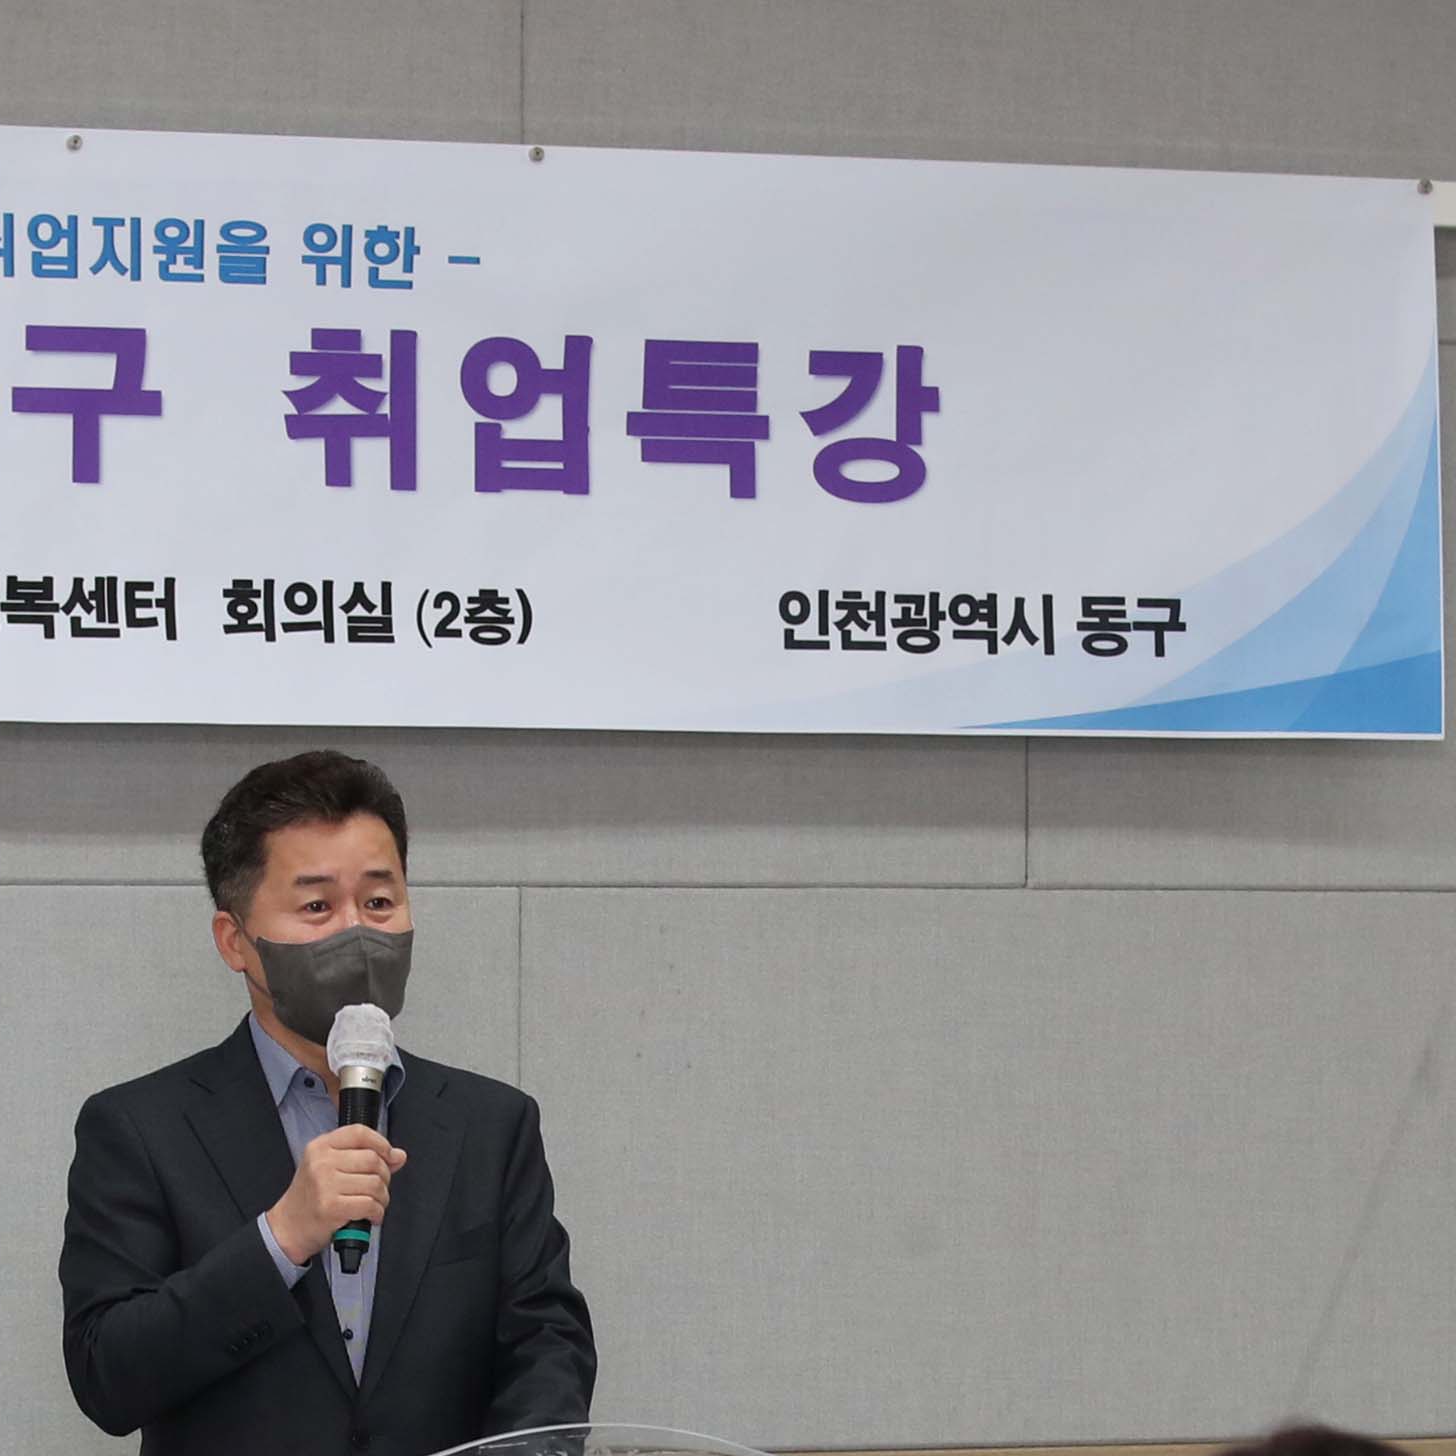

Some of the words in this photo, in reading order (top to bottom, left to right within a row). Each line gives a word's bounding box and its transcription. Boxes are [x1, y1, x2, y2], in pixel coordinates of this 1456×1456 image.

[302, 223, 421, 290] 위한
[285, 328, 942, 505] 취업특강
[222, 578, 397, 646] 회의실
[416, 588, 534, 649] (2층)
[778, 589, 1057, 657] 인천광역시
[1076, 596, 1189, 660] 동구
